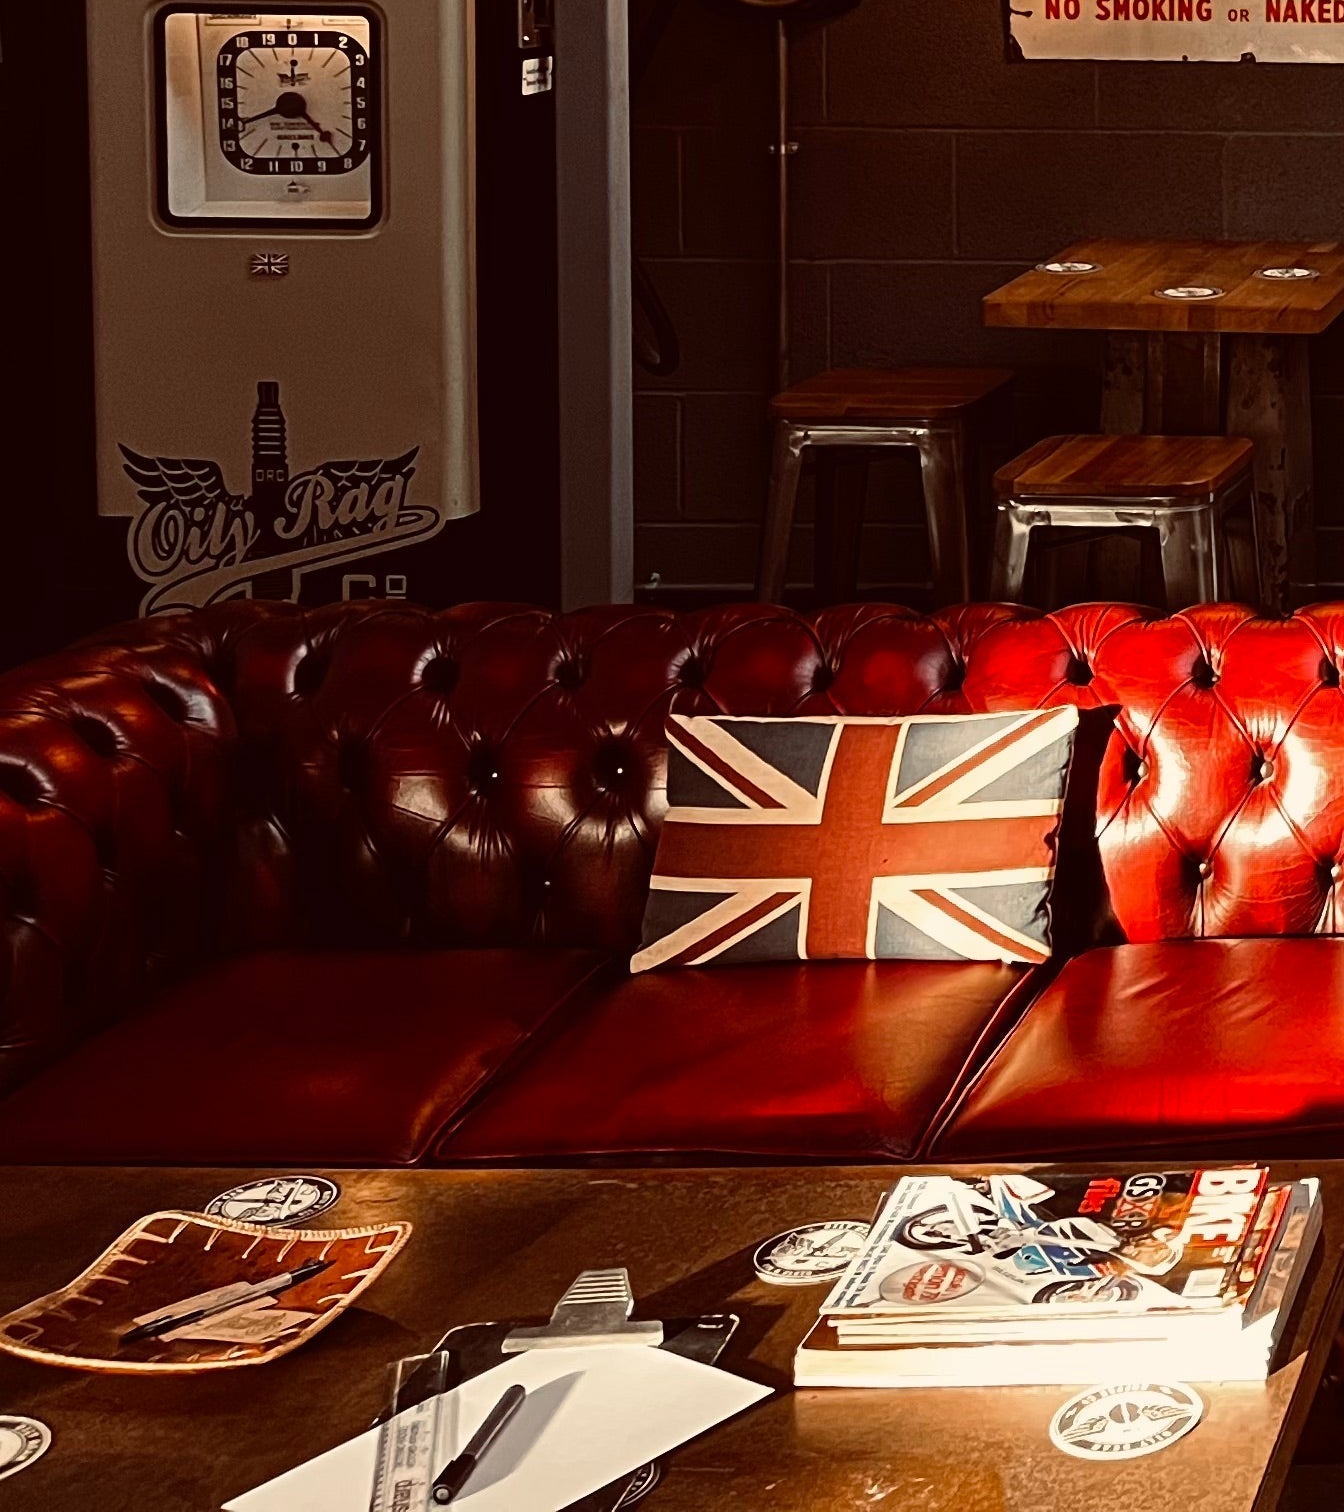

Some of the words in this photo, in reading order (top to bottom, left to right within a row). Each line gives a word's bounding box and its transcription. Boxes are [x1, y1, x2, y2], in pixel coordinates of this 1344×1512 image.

[1227, 8, 1250, 23] OR
[262, 33, 276, 45] 19
[338, 37, 348, 48] 2
[219, 54, 232, 66] 17
[355, 54, 364, 66] 3
[220, 77, 234, 89] 16
[356, 77, 365, 88] 4
[221, 97, 234, 109] 15
[356, 97, 366, 109] 5
[357, 118, 366, 130] 6
[223, 140, 236, 152] 13
[357, 140, 366, 151] 7
[240, 158, 254, 170] 12
[268, 161, 279, 172] 11
[290, 161, 304, 172] 10
[317, 161, 326, 172] 9
[344, 158, 353, 169] 8
[255, 469, 286, 482] ORC
[128, 498, 261, 585] Oily
[273, 472, 420, 540] Rag
